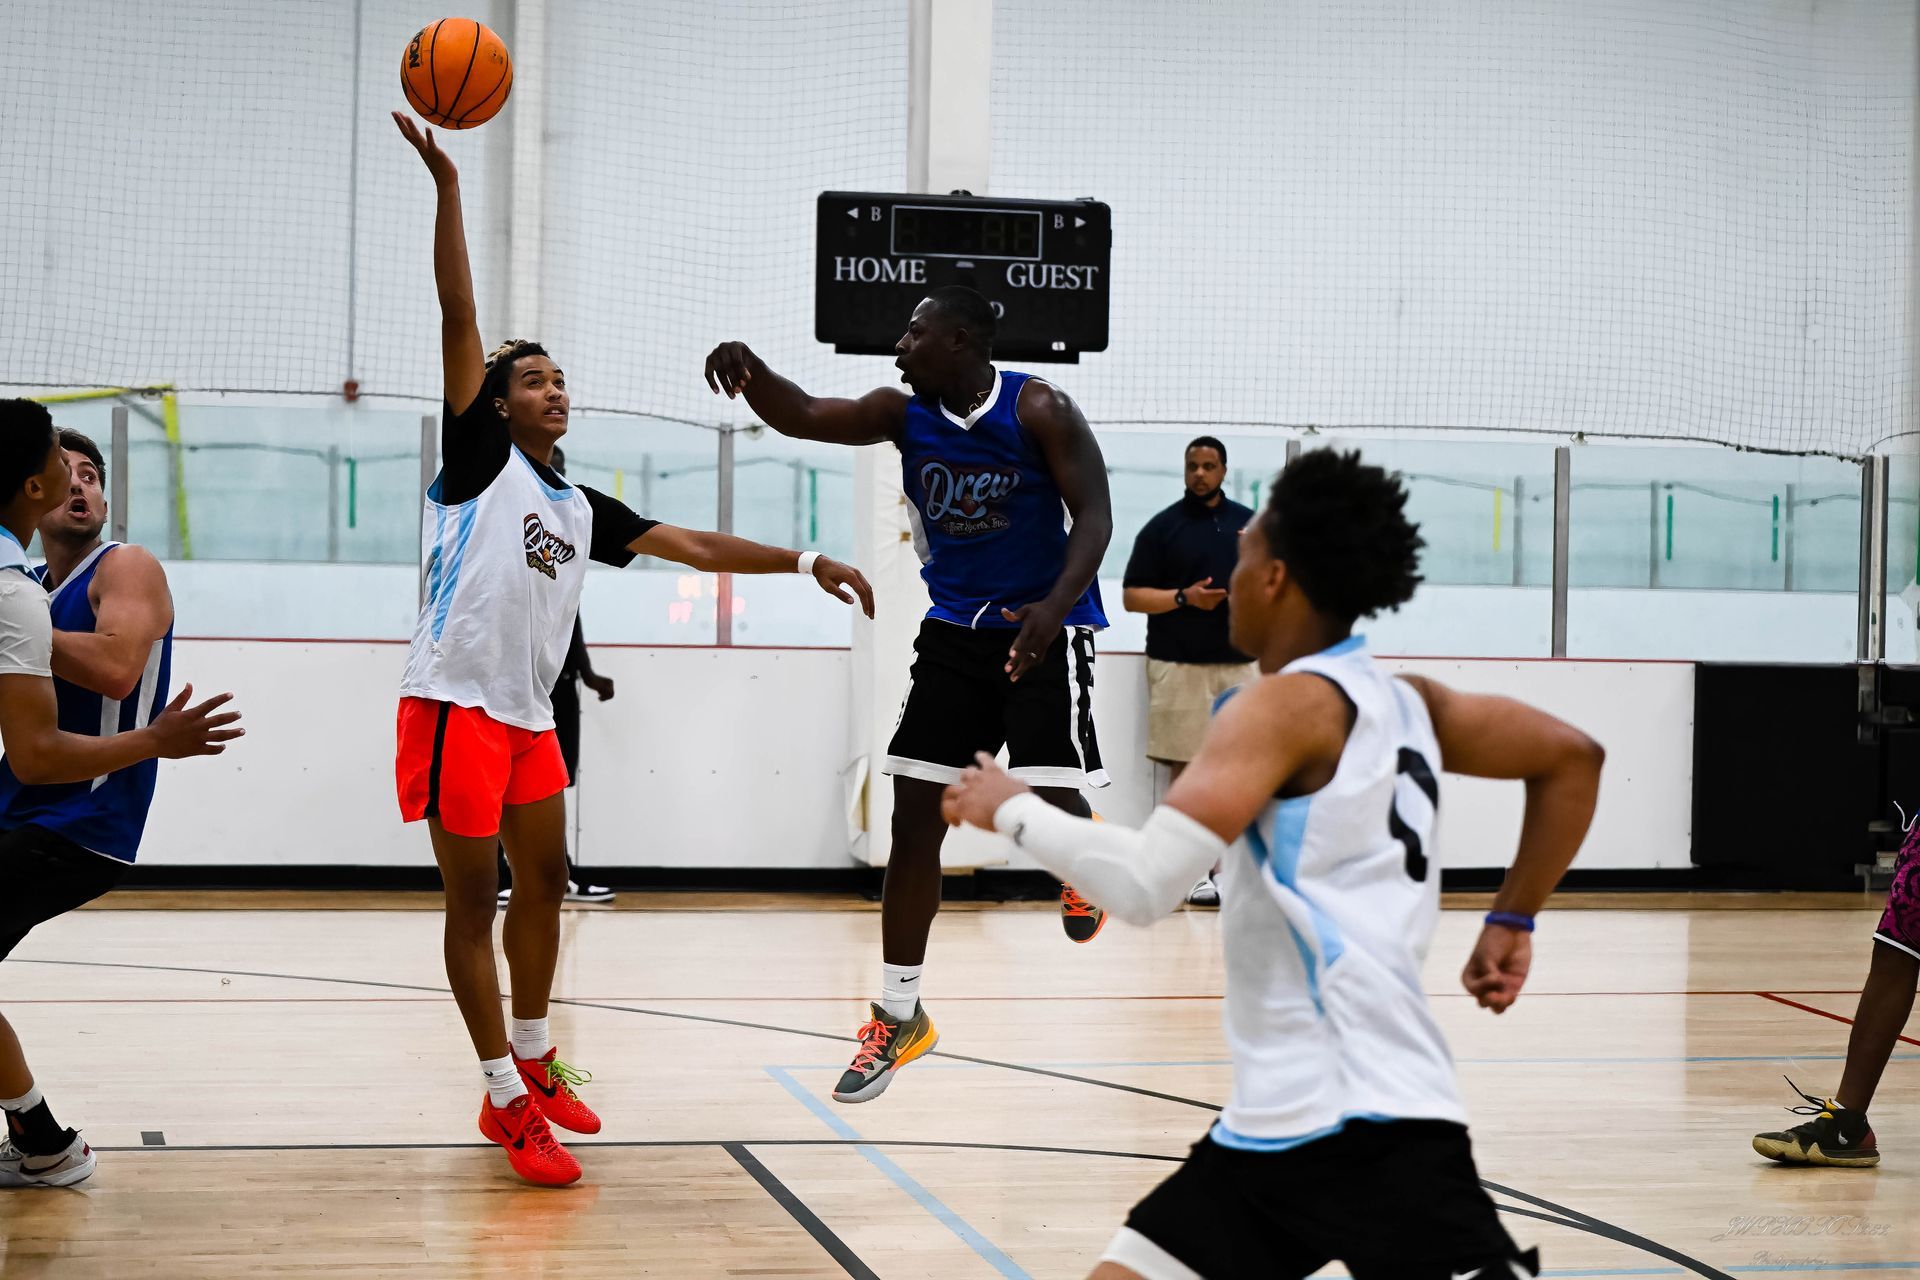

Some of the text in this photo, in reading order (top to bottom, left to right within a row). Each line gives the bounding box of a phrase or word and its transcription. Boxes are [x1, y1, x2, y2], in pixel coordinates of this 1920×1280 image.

[870, 207, 882, 222] B
[1054, 214, 1064, 229] B
[834, 256, 927, 284] HOME
[1006, 263, 1099, 290] GUEST
[920, 461, 1020, 520] Drew
[524, 517, 574, 566] Drew
